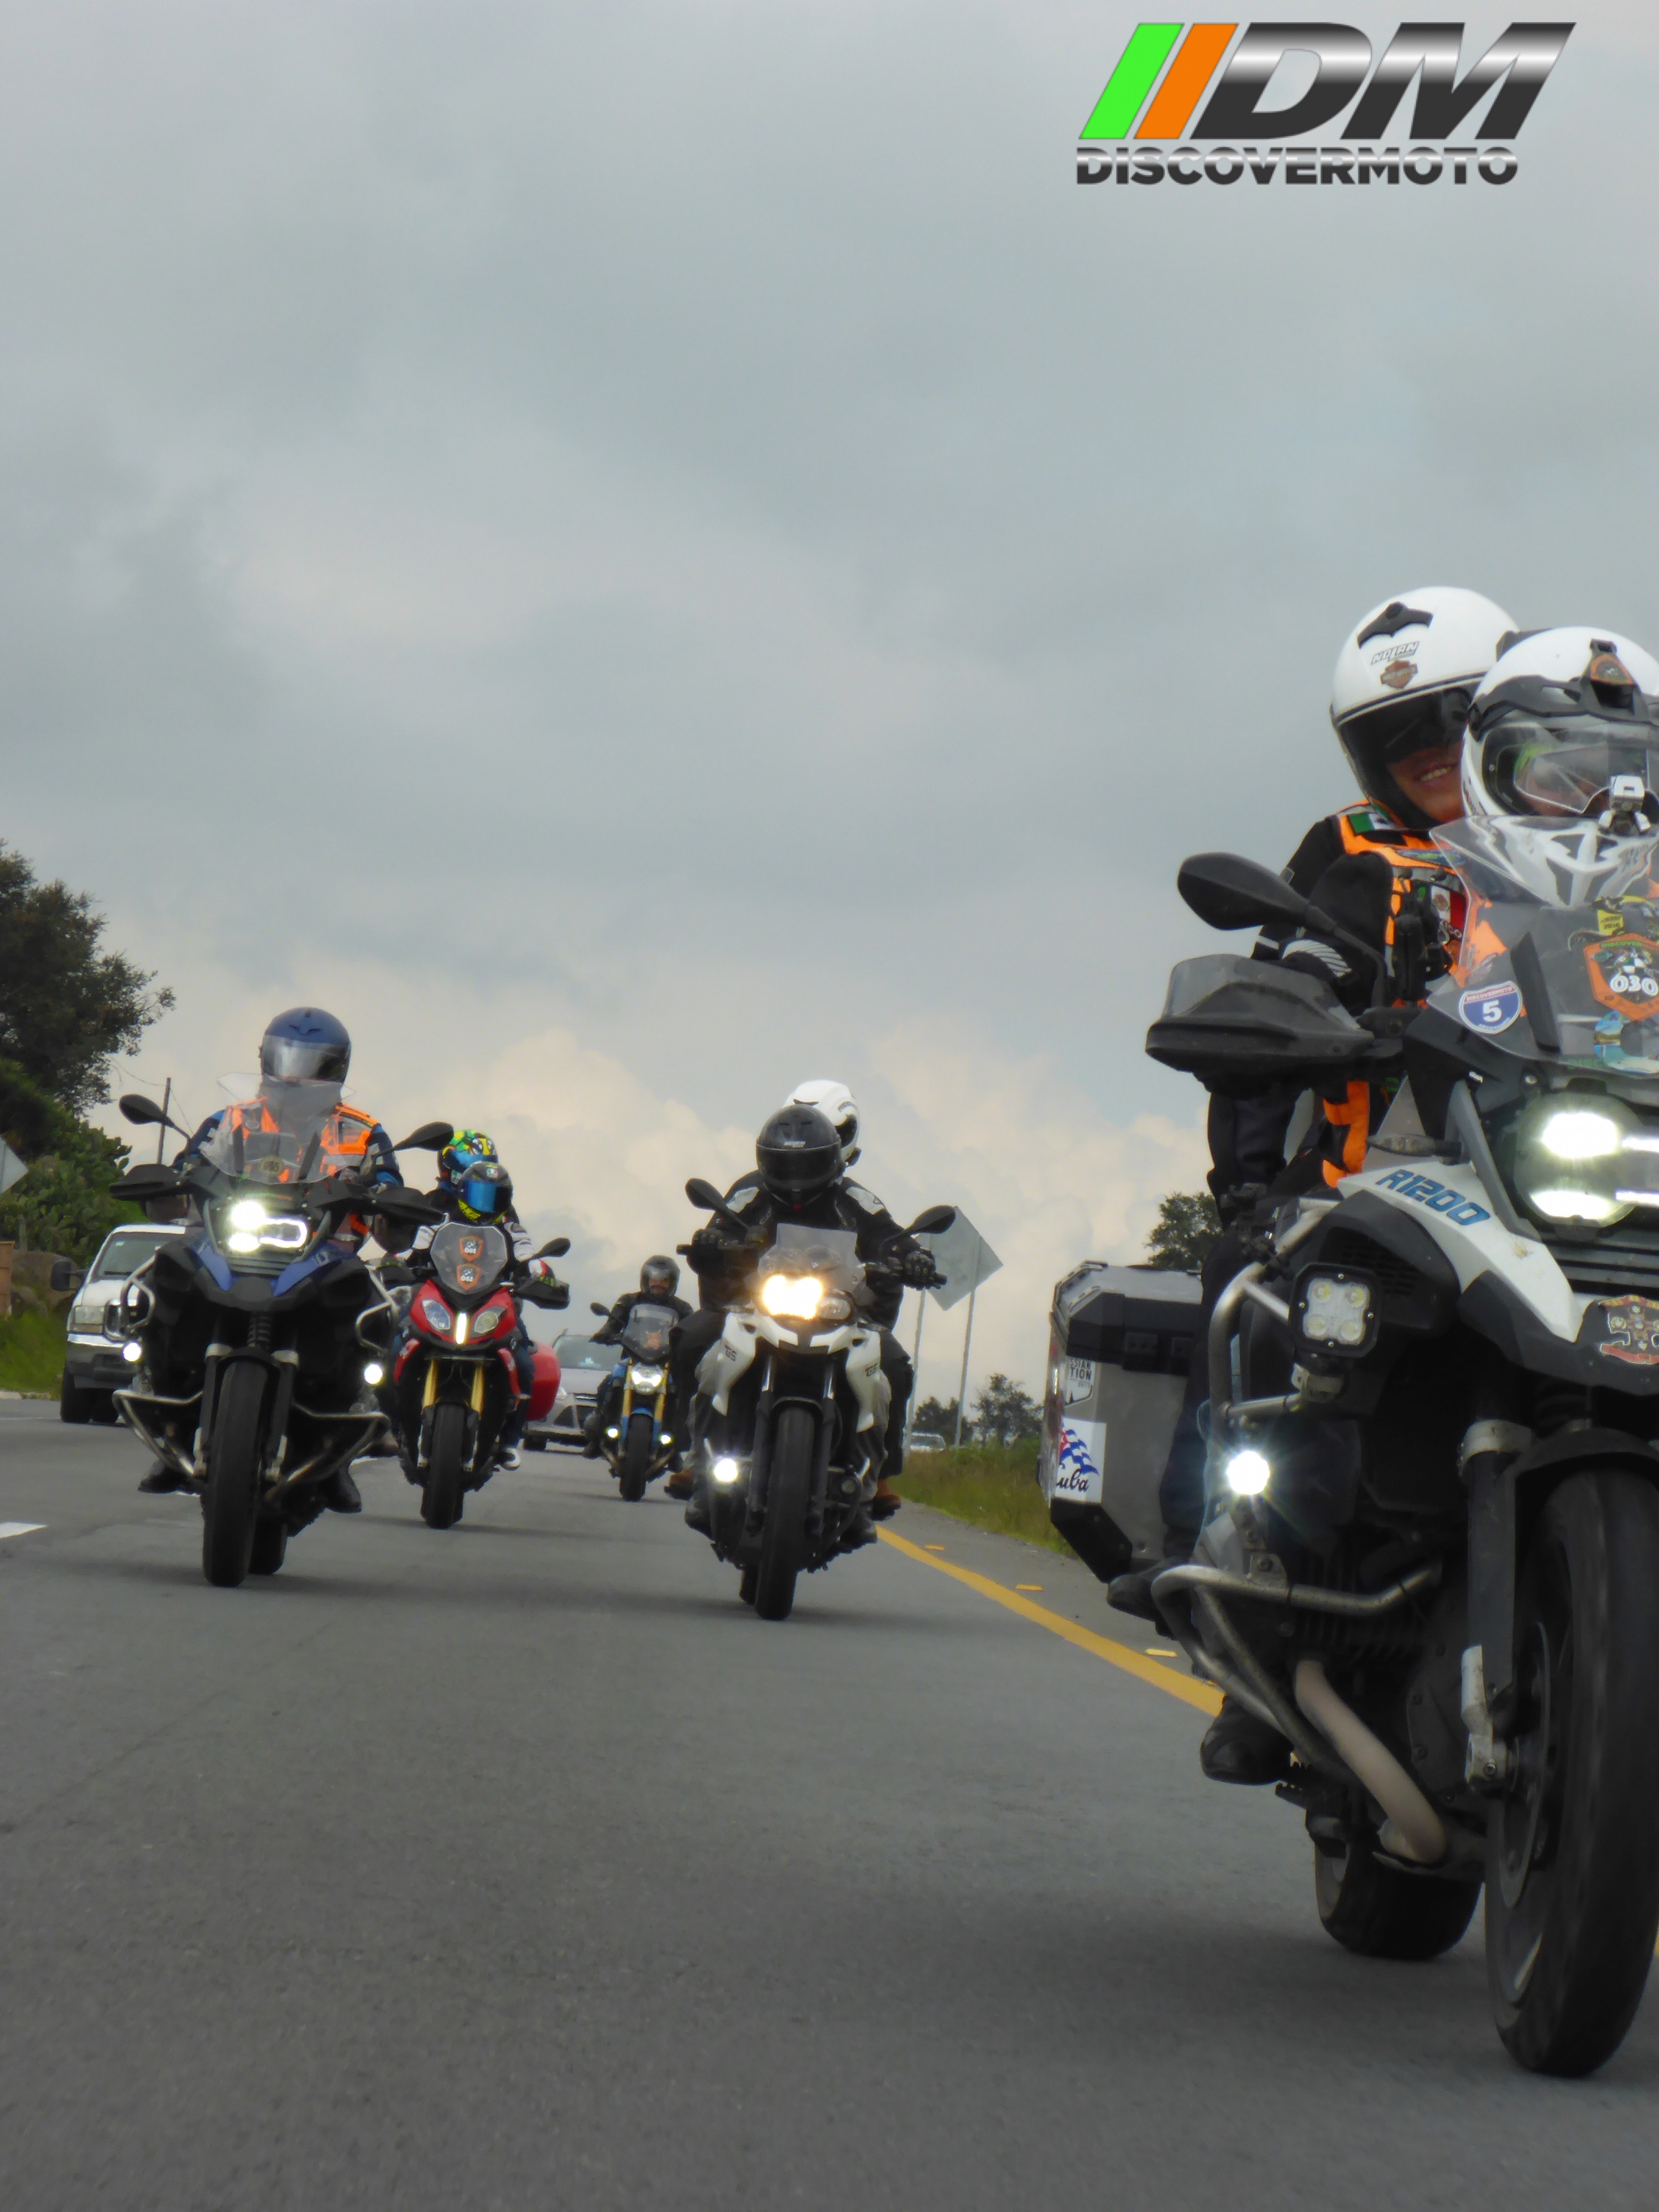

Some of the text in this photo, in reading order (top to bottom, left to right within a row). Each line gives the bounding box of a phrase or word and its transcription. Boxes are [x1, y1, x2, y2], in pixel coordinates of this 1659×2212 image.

[1371, 641, 1420, 665] NOLAN
[1466, 986, 1512, 1001] DISCOVERMOTO
[1610, 975, 1659, 996] 030
[1483, 1000, 1502, 1022] 5
[1375, 1169, 1491, 1226] R1200
[1056, 1465, 1089, 1493] uba
